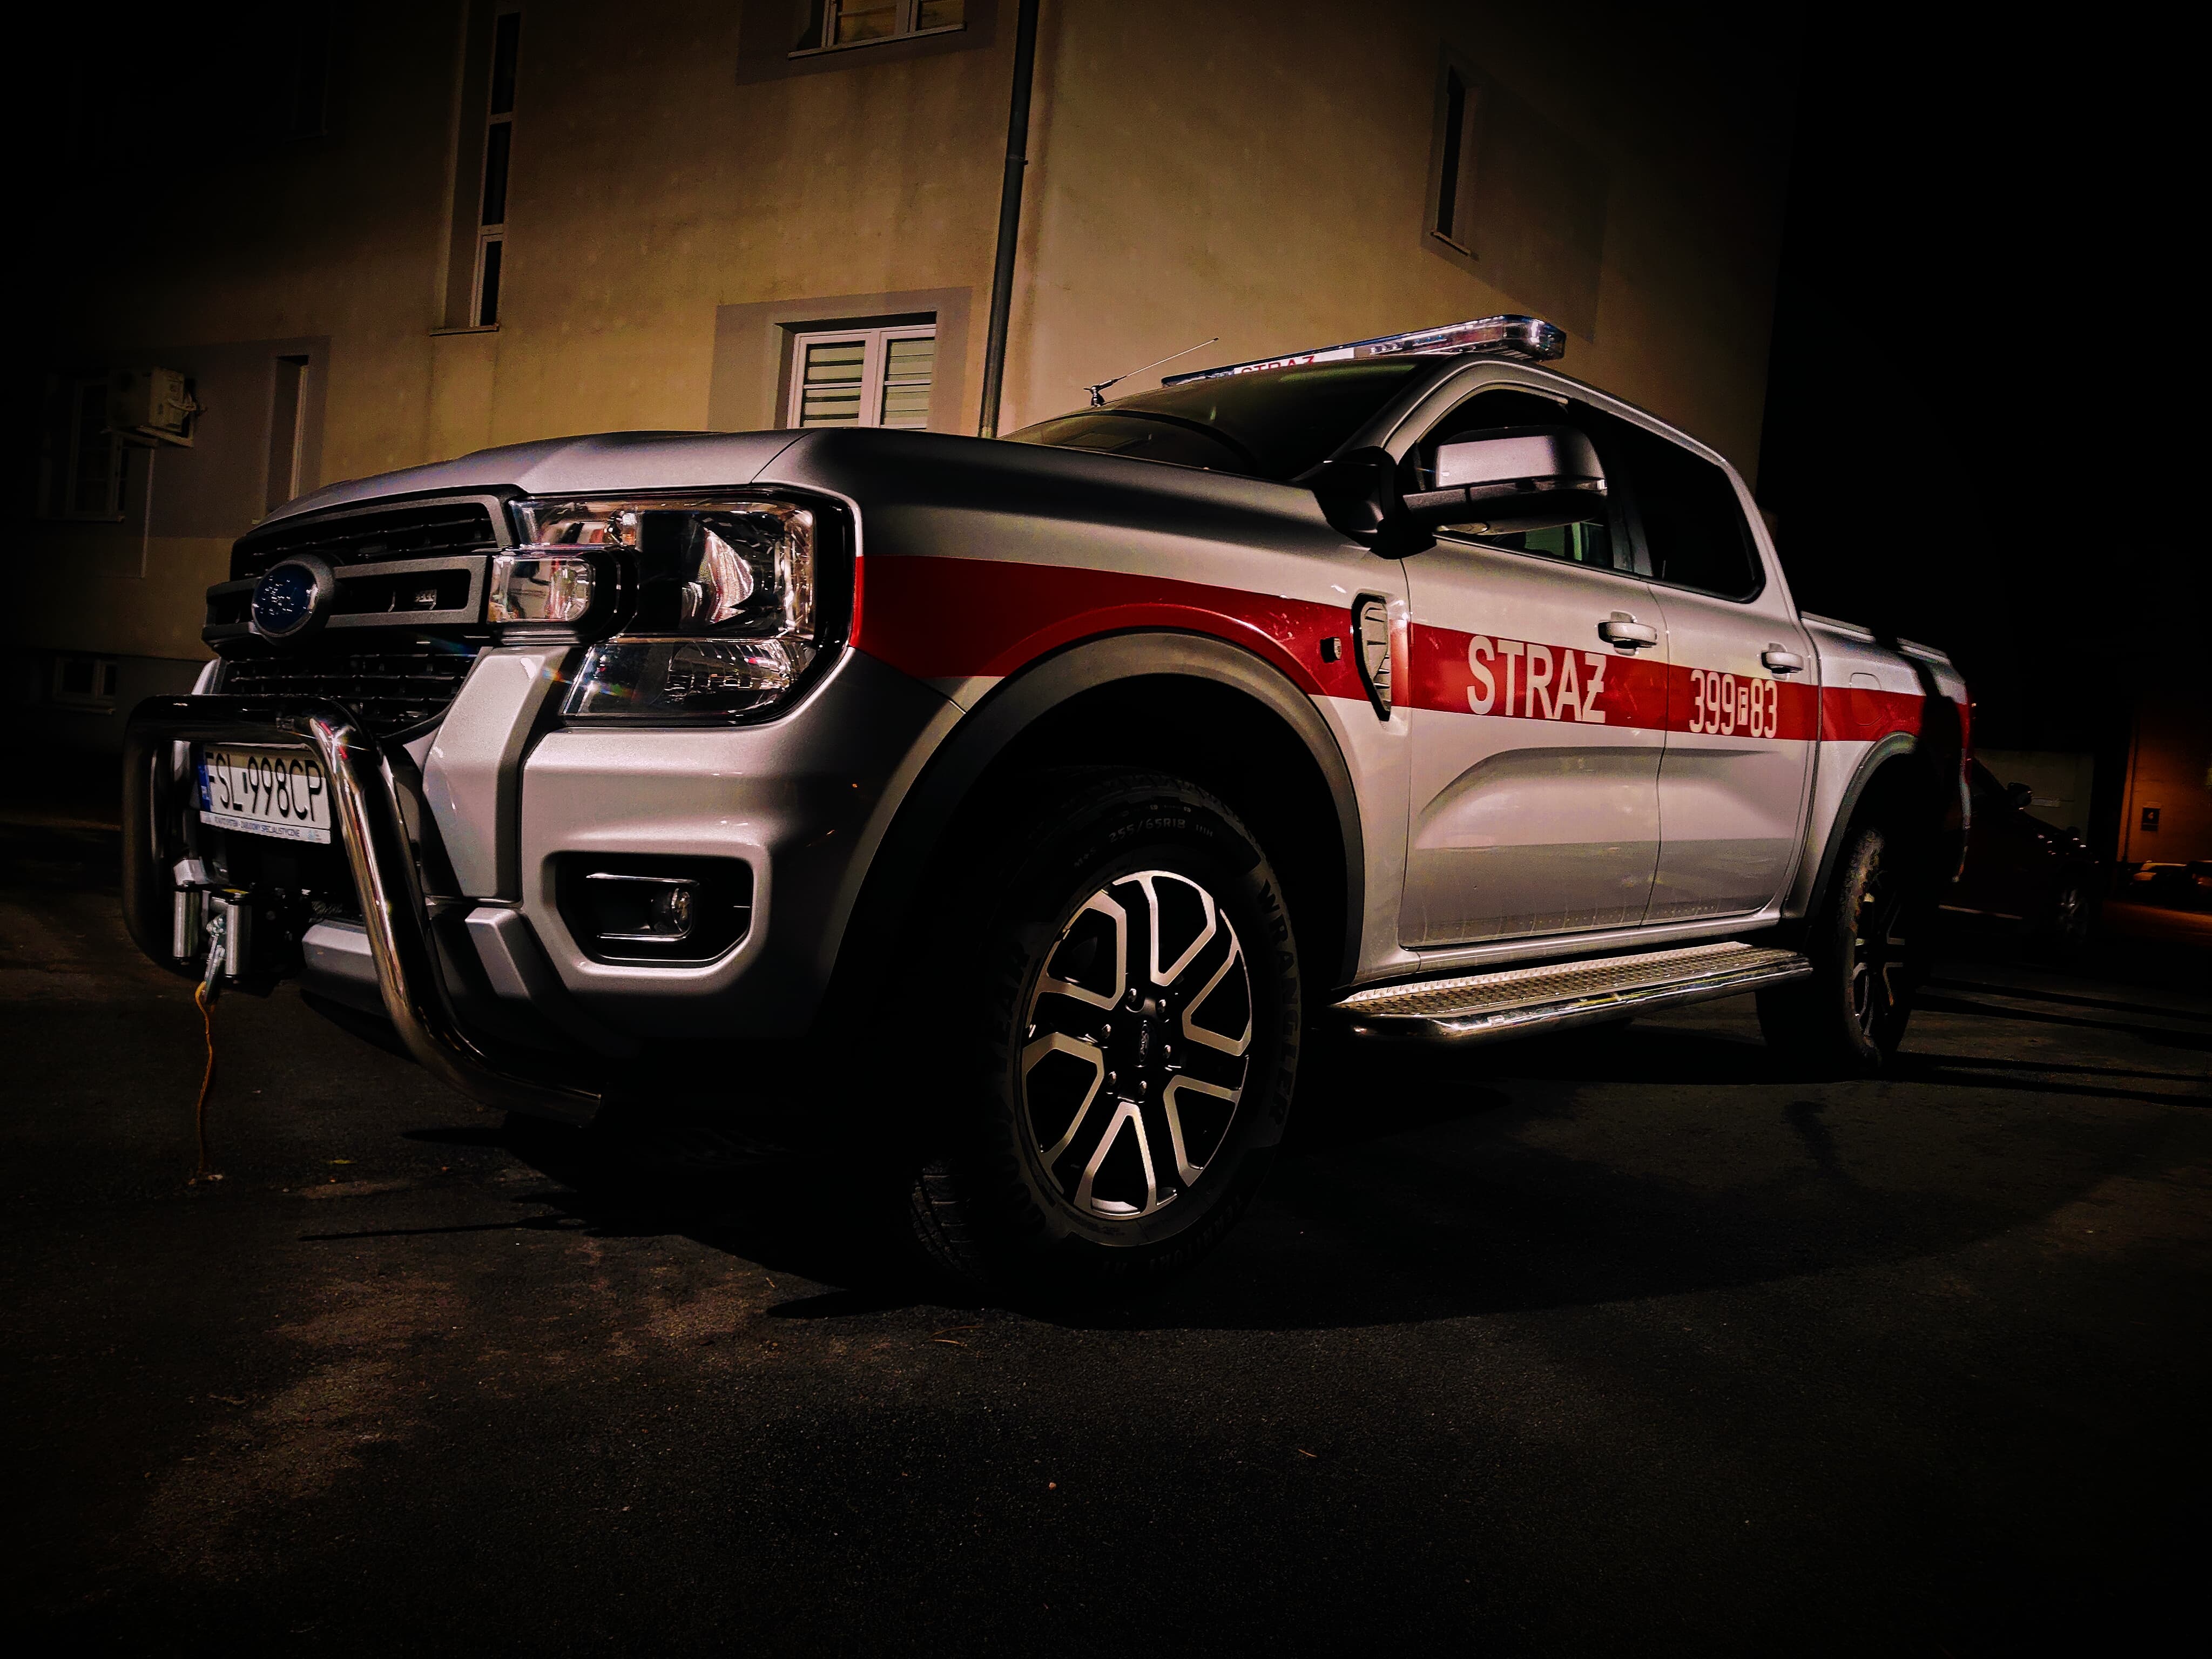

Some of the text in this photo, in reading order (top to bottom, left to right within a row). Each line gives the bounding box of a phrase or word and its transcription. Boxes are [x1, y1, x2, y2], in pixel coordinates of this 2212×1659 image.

[1467, 635, 1607, 723] STRAŻ
[248, 756, 322, 821] 998CP
[1257, 878, 1299, 1126] WRANGLER
